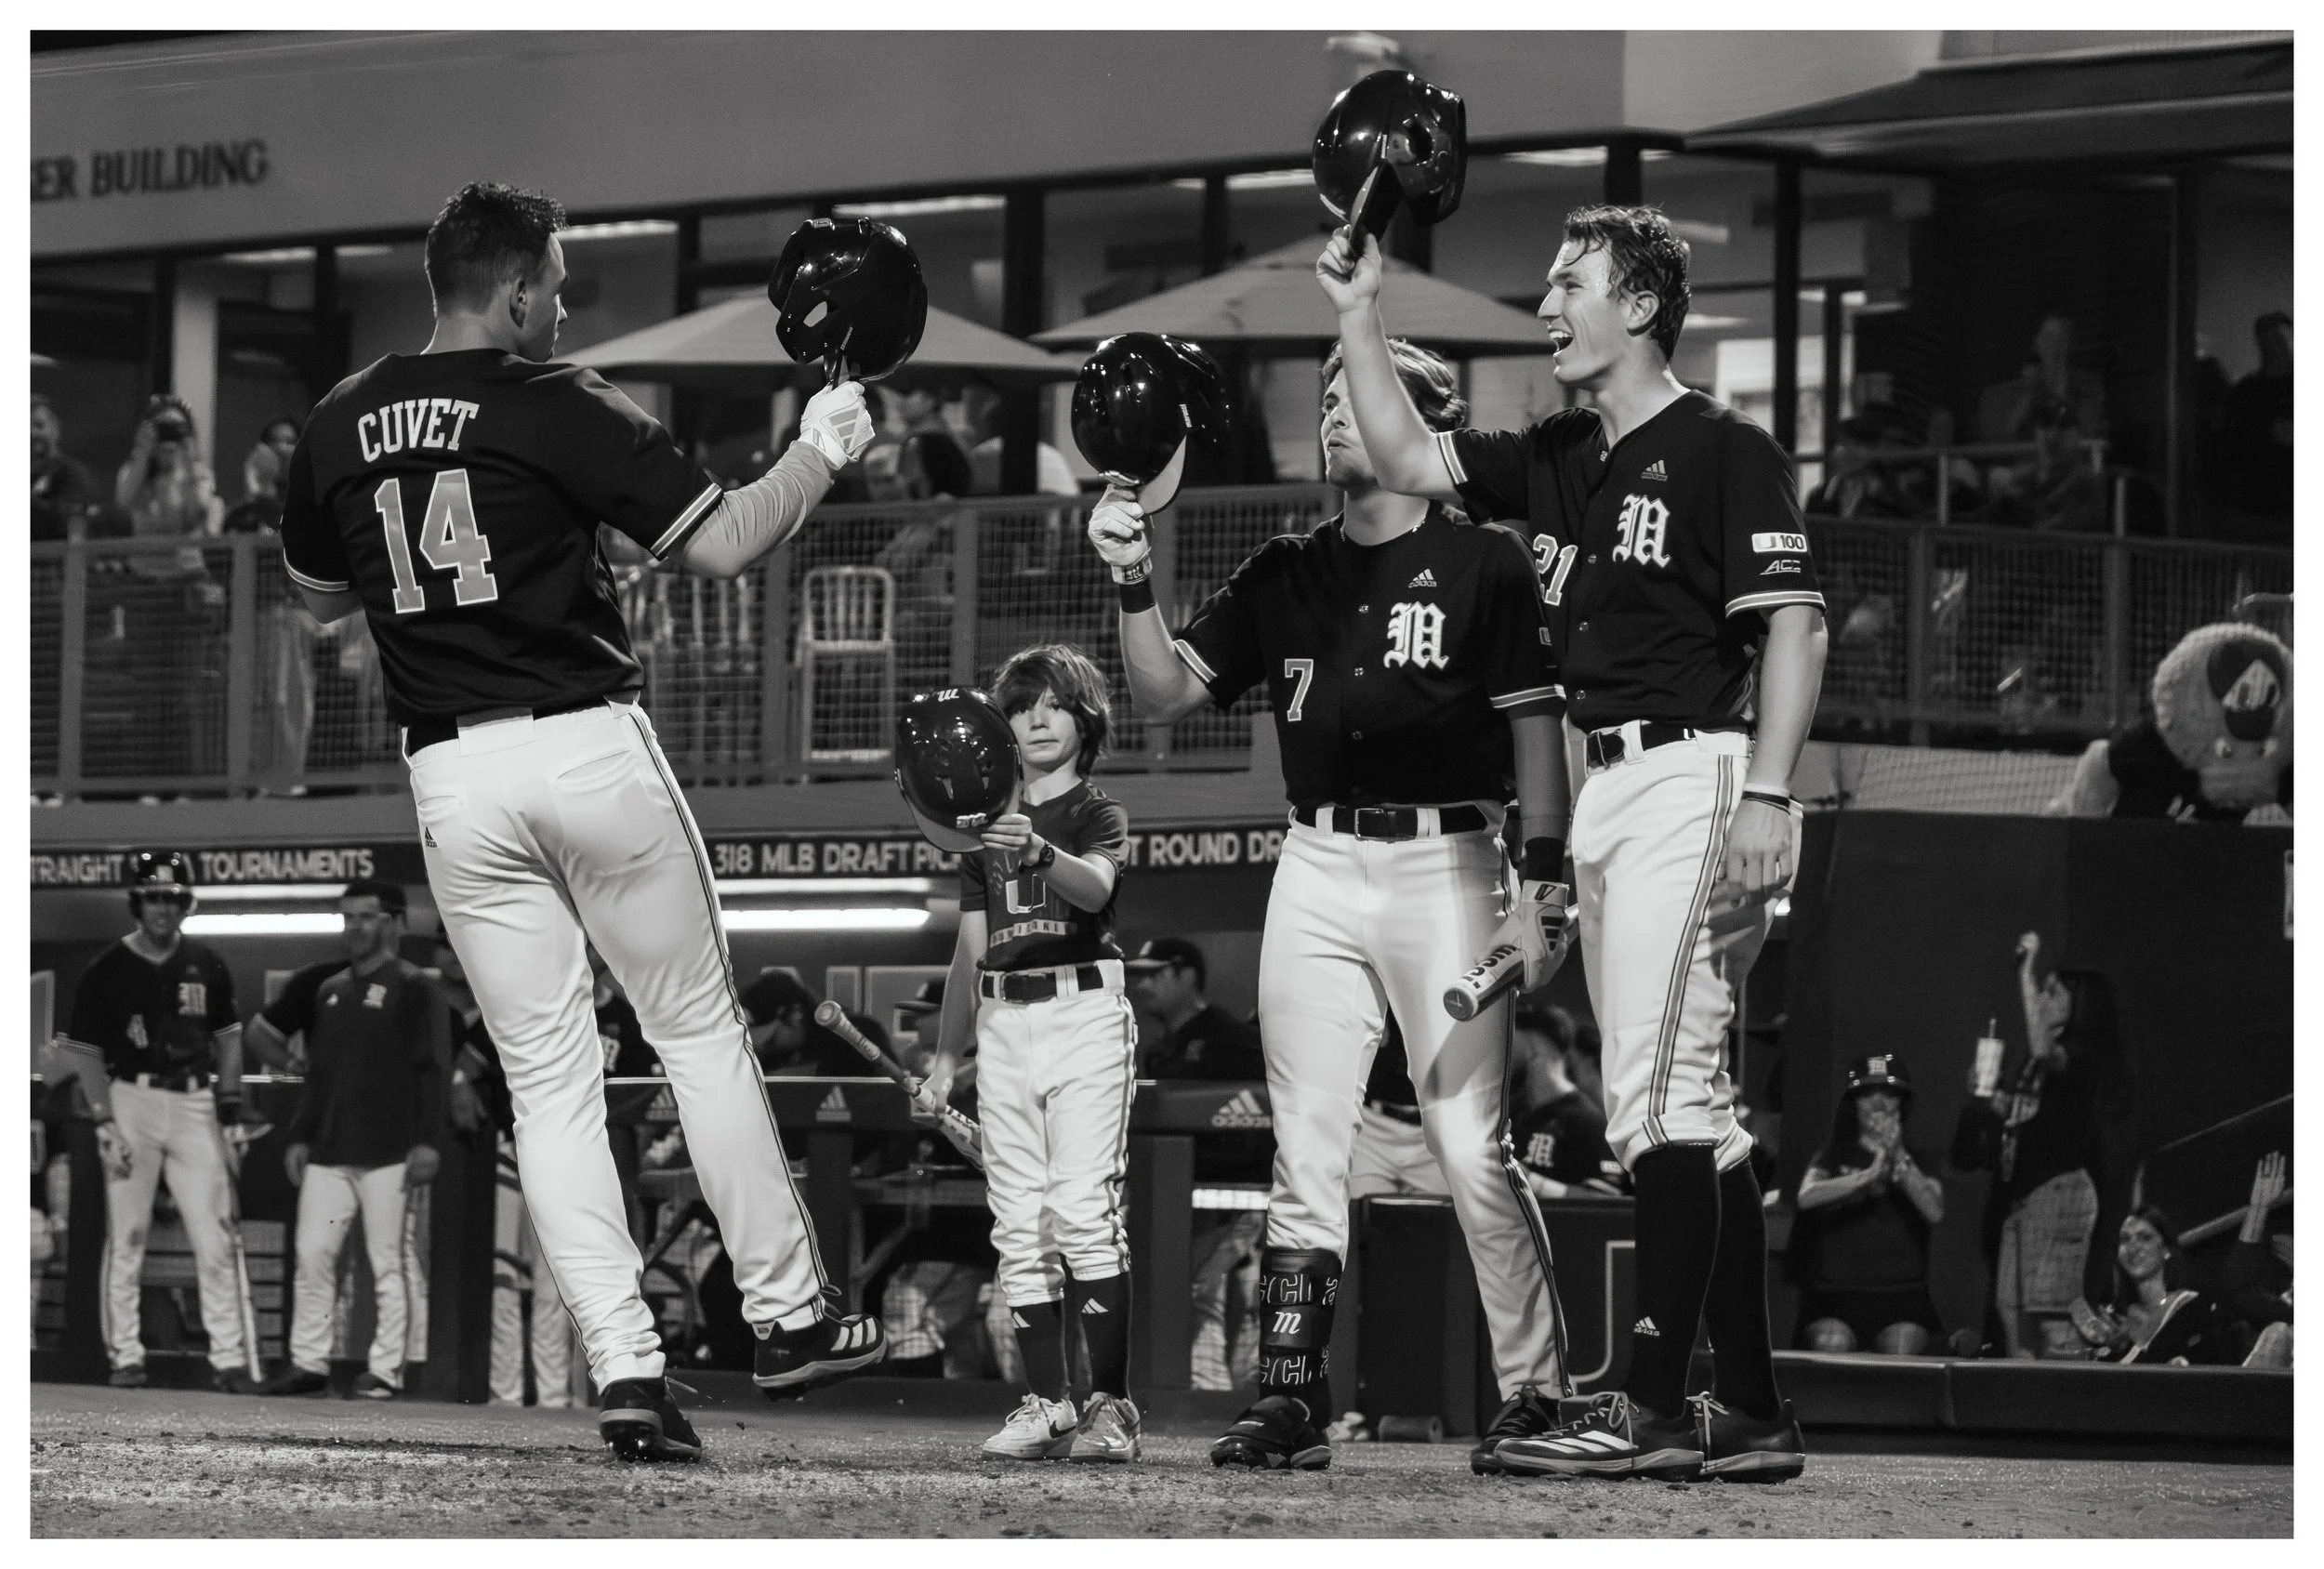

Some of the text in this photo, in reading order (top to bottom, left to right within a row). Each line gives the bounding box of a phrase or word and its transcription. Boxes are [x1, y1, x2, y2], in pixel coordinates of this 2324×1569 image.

[31, 137, 268, 202] ER BUILDING
[357, 398, 481, 463] CUVET
[374, 468, 499, 614] 14
[1779, 534, 1805, 551] 100
[1532, 533, 1578, 607] 21
[1284, 658, 1314, 722] 7
[198, 848, 374, 883] TOURNAMENTS
[713, 842, 753, 875] 318
[760, 841, 816, 874] MLB
[822, 840, 912, 874] DRAFT
[1148, 833, 1242, 867] ROUND
[1247, 830, 1285, 864] DR
[31, 854, 125, 883] TRAIGHT
[126, 1013, 149, 1049] 4
